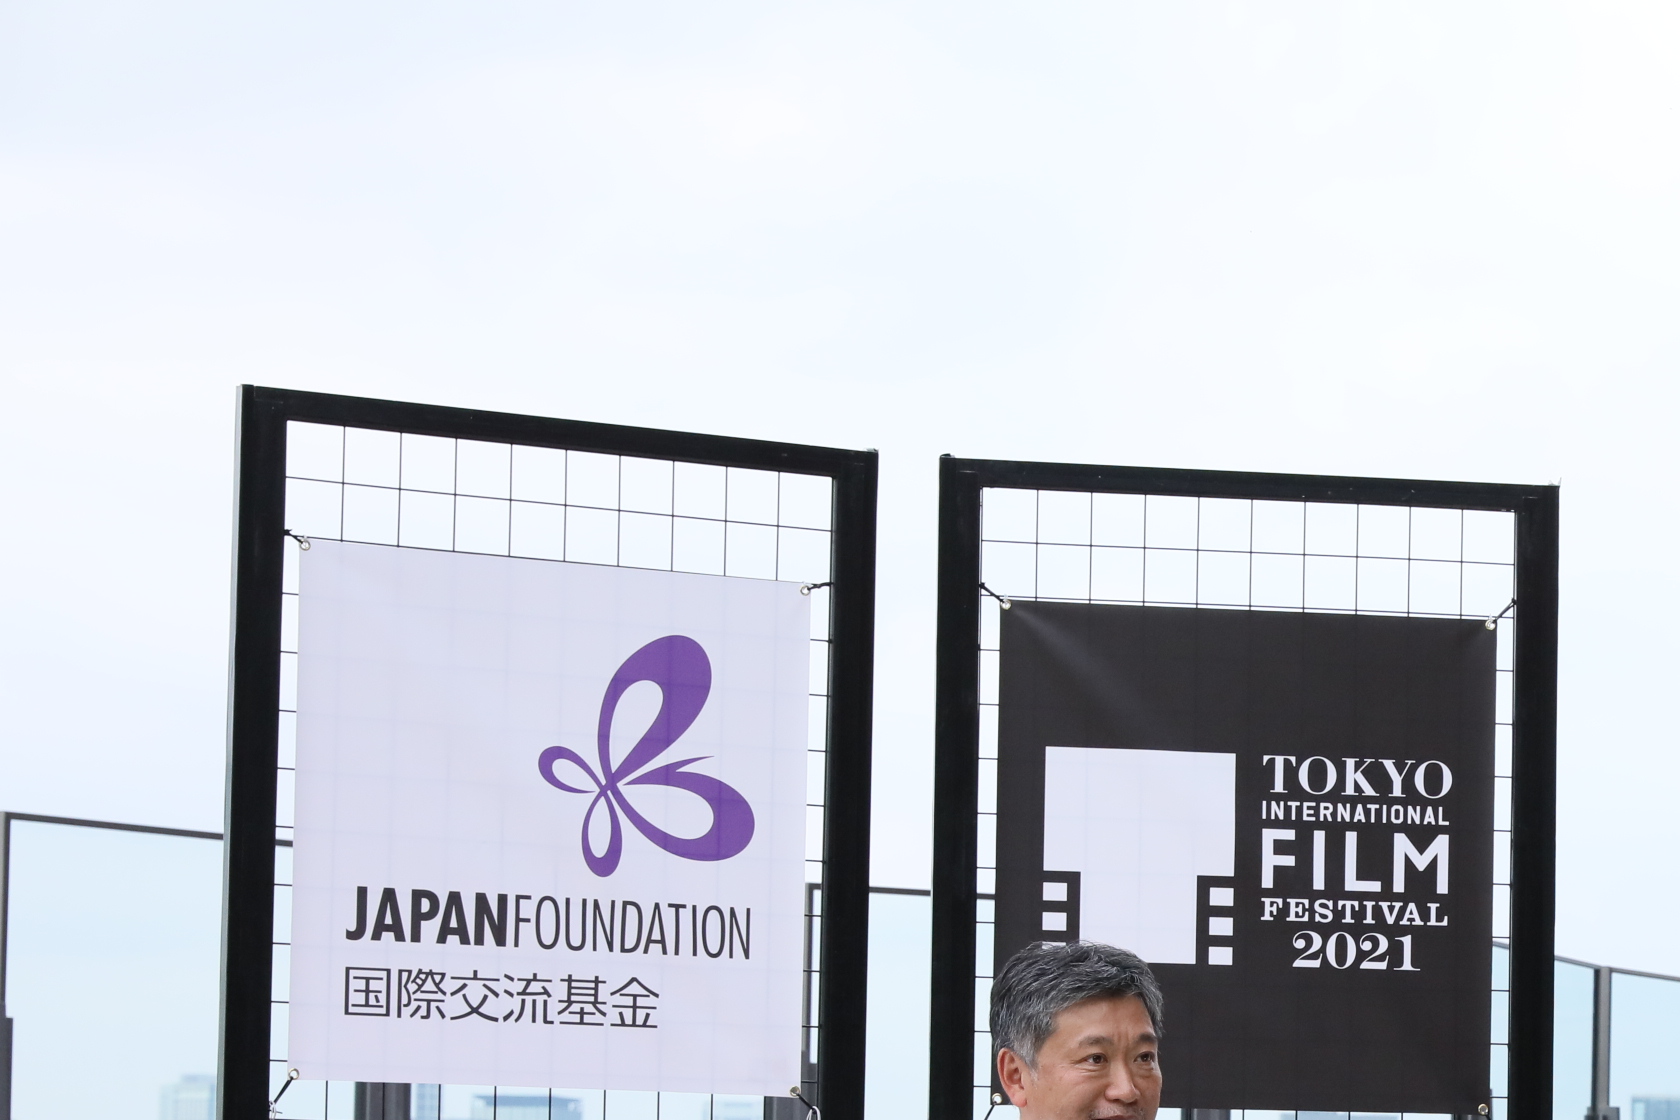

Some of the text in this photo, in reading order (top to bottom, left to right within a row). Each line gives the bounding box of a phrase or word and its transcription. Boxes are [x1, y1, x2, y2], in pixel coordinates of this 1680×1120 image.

[1262, 755, 1453, 799] TOKYO
[1261, 800, 1450, 826] INTERNATIONAL
[1261, 828, 1450, 895] FILM
[1260, 897, 1449, 927] FESTIVAL
[1292, 930, 1421, 971] 2021
[343, 966, 660, 1029] 国際交流基金
